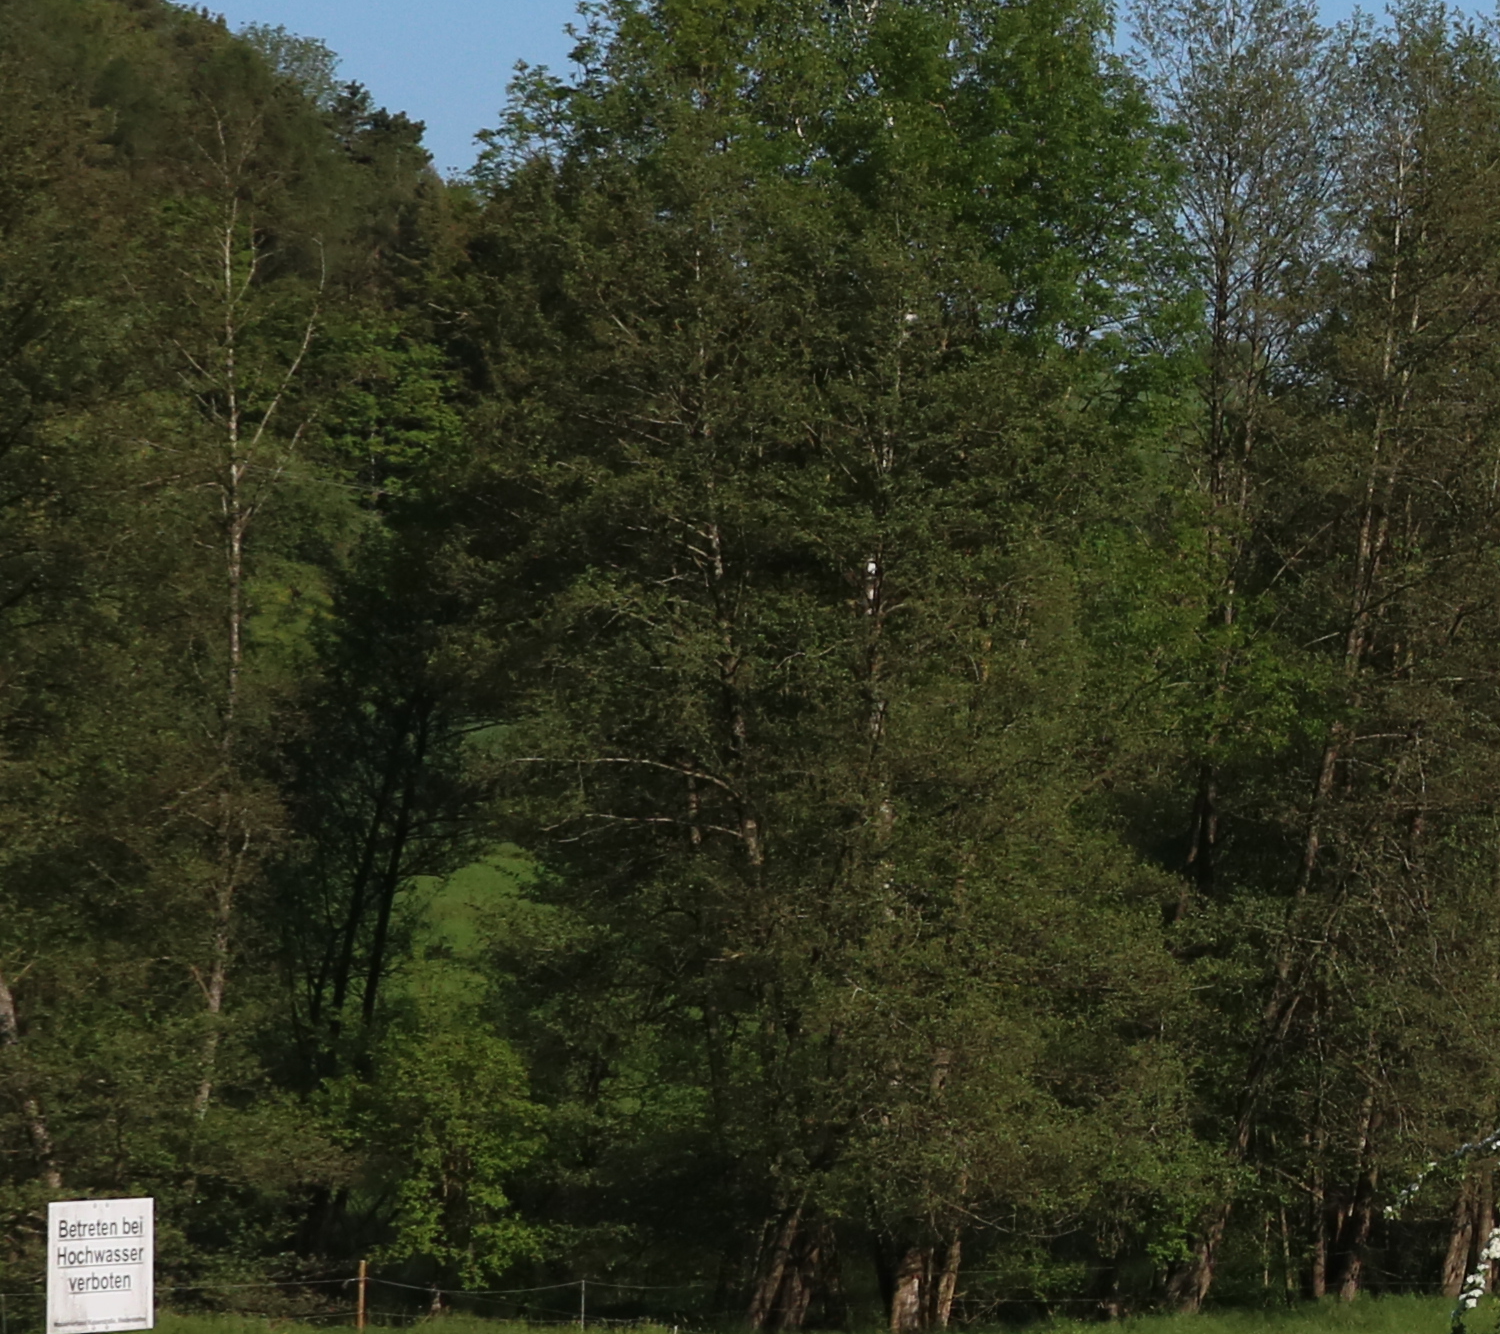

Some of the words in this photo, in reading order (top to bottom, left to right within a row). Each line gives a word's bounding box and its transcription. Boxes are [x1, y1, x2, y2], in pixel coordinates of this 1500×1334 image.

[58, 1218, 118, 1239] Betreten
[122, 1216, 144, 1236] bei
[56, 1246, 144, 1266] Hochwasser
[69, 1272, 131, 1291] verboten
